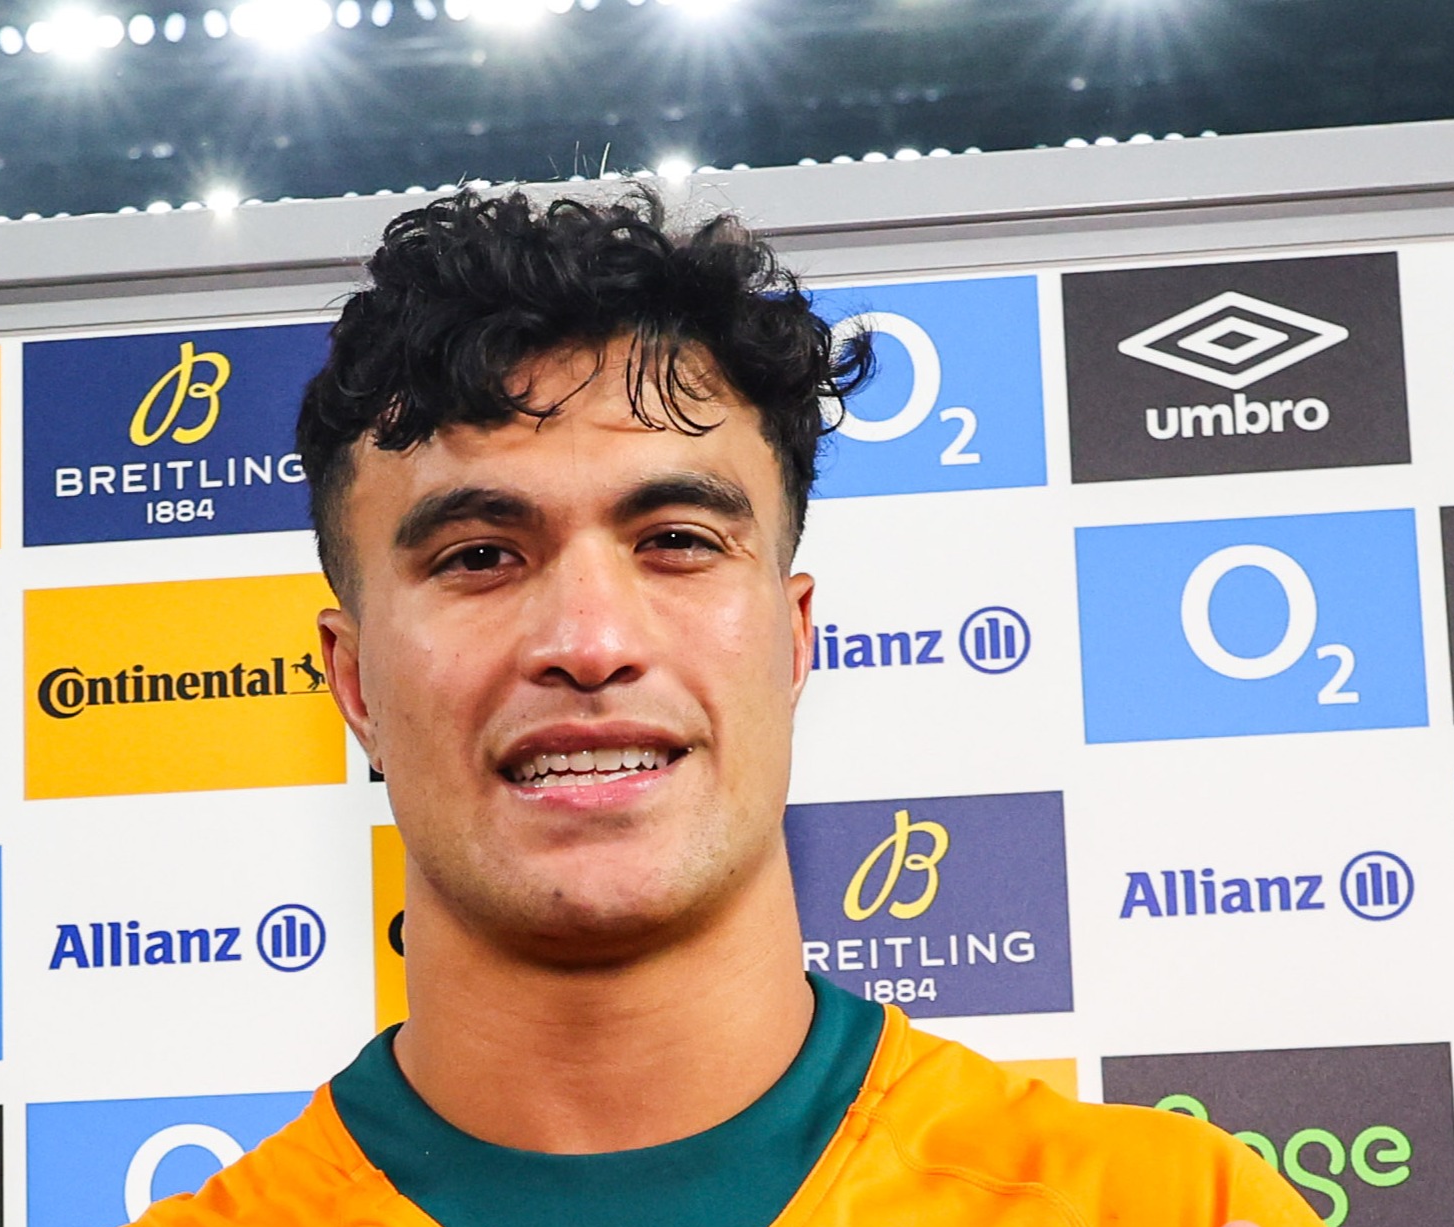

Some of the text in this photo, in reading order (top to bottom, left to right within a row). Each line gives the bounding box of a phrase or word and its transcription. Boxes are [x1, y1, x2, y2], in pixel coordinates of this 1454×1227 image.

[1146, 393, 1329, 440] umbro
[54, 452, 308, 498] BREITLING
[145, 497, 216, 525] 1884
[812, 624, 944, 671] lianz
[38, 657, 287, 719] Continental
[1120, 868, 1325, 919] Allianz
[49, 920, 242, 970] Allianz
[801, 931, 1035, 972] REITLING
[864, 978, 937, 1005] 1884
